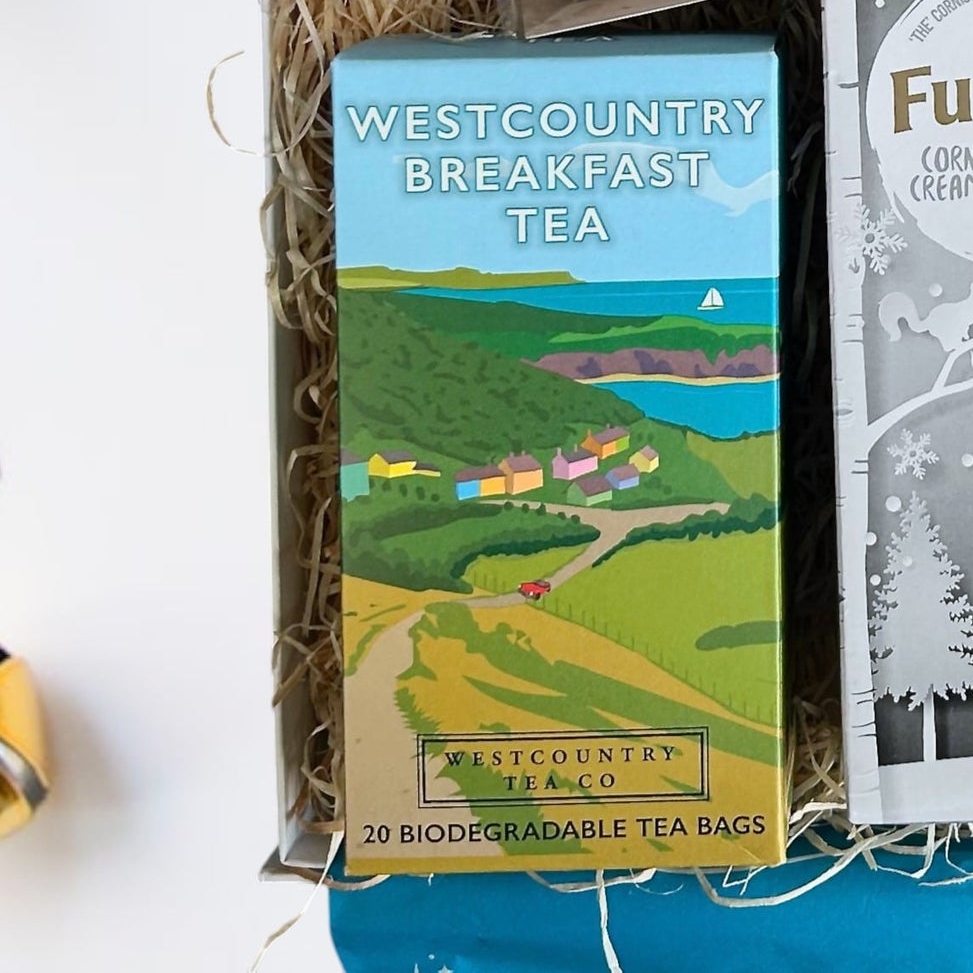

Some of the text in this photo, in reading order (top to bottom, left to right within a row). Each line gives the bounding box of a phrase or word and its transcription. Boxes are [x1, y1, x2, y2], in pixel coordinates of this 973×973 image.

[346, 99, 766, 142] WESTCOUNTRY
[405, 152, 710, 193] BREAKFAST
[505, 206, 610, 243] TEA
[445, 746, 677, 767] WESTCOUNTRY
[503, 773, 617, 791] TEA CO
[362, 815, 766, 844] 20 BIODEGRADABLE TEA BAGS
